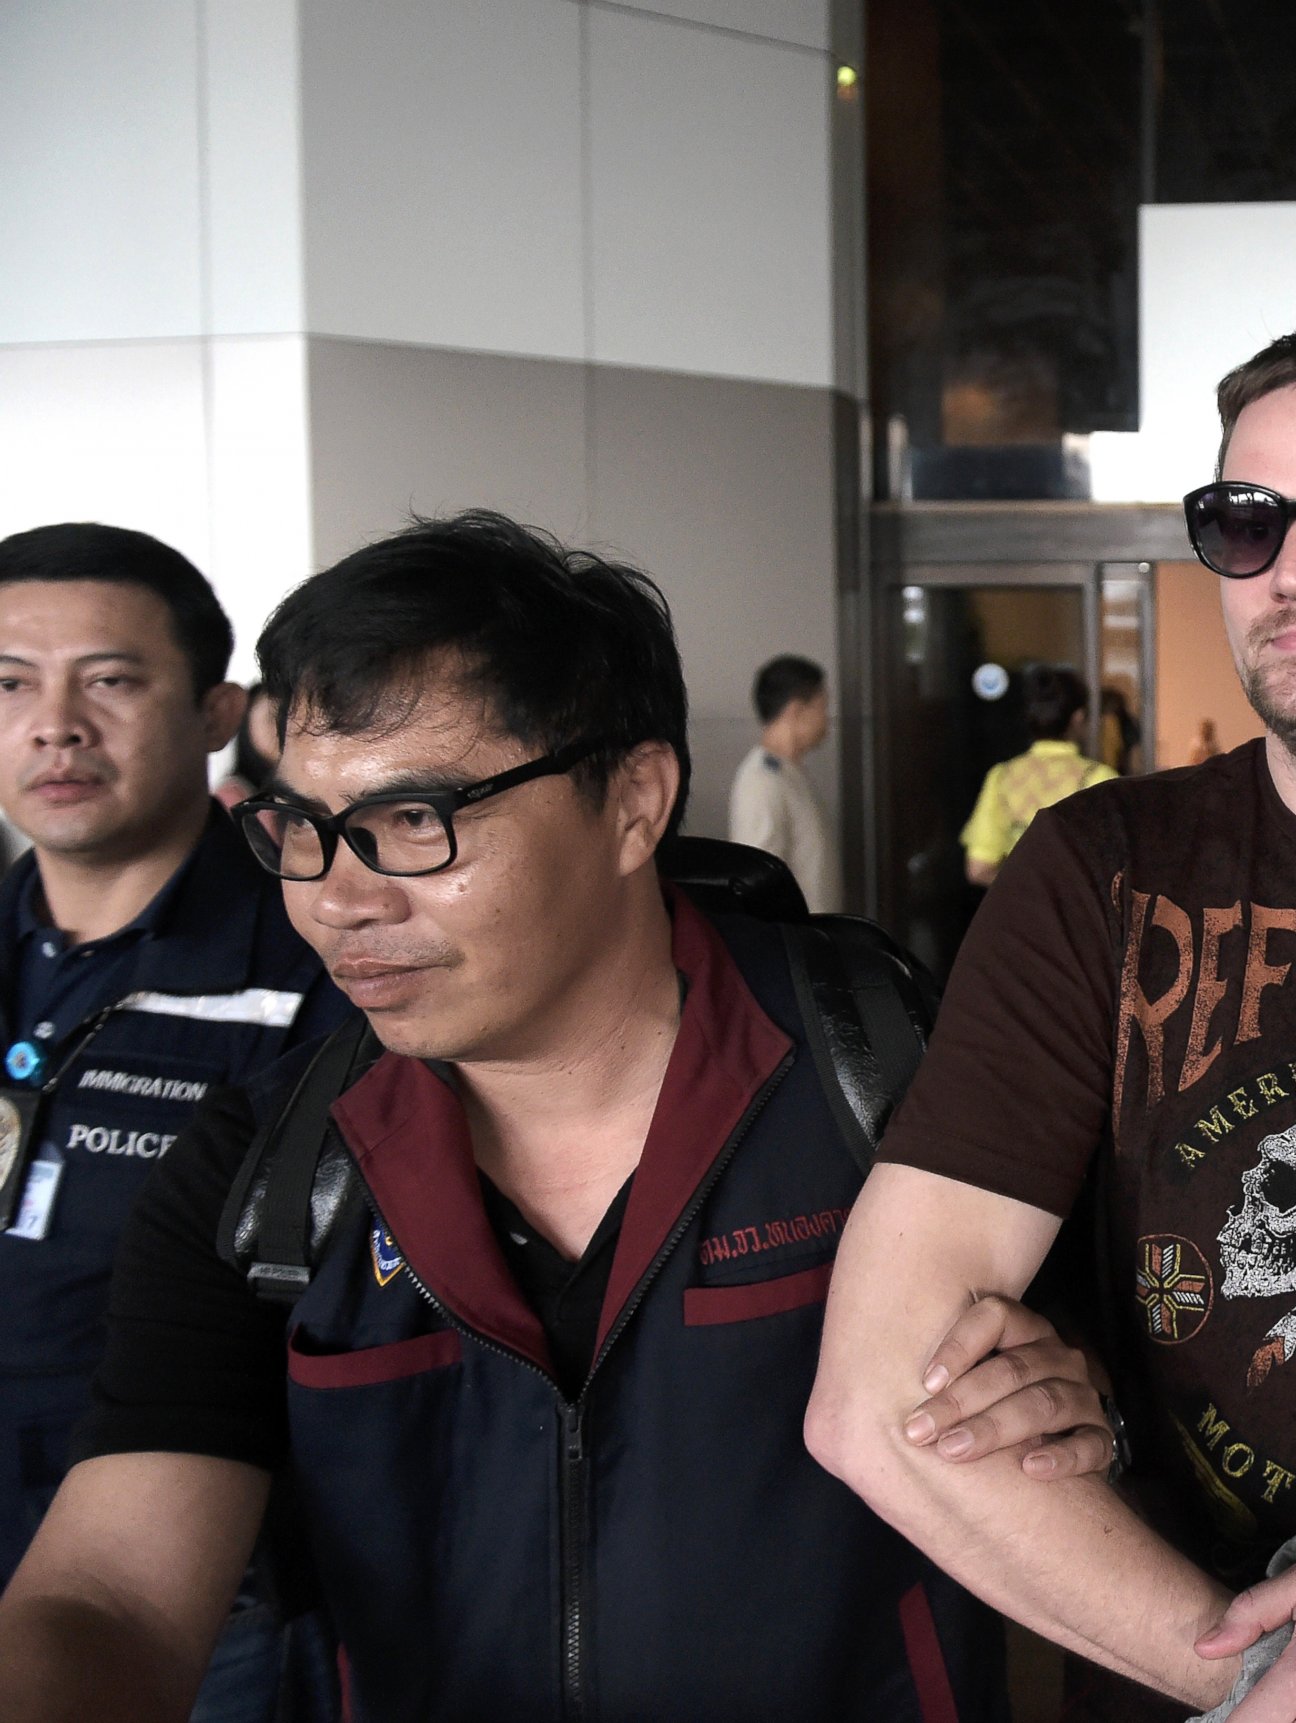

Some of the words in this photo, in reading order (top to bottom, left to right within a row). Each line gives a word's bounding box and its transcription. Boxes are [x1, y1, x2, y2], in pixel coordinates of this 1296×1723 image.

[78, 1069, 209, 1102] IMMIGRATION
[700, 1210, 851, 1266] ตม.จว.หนองคา
